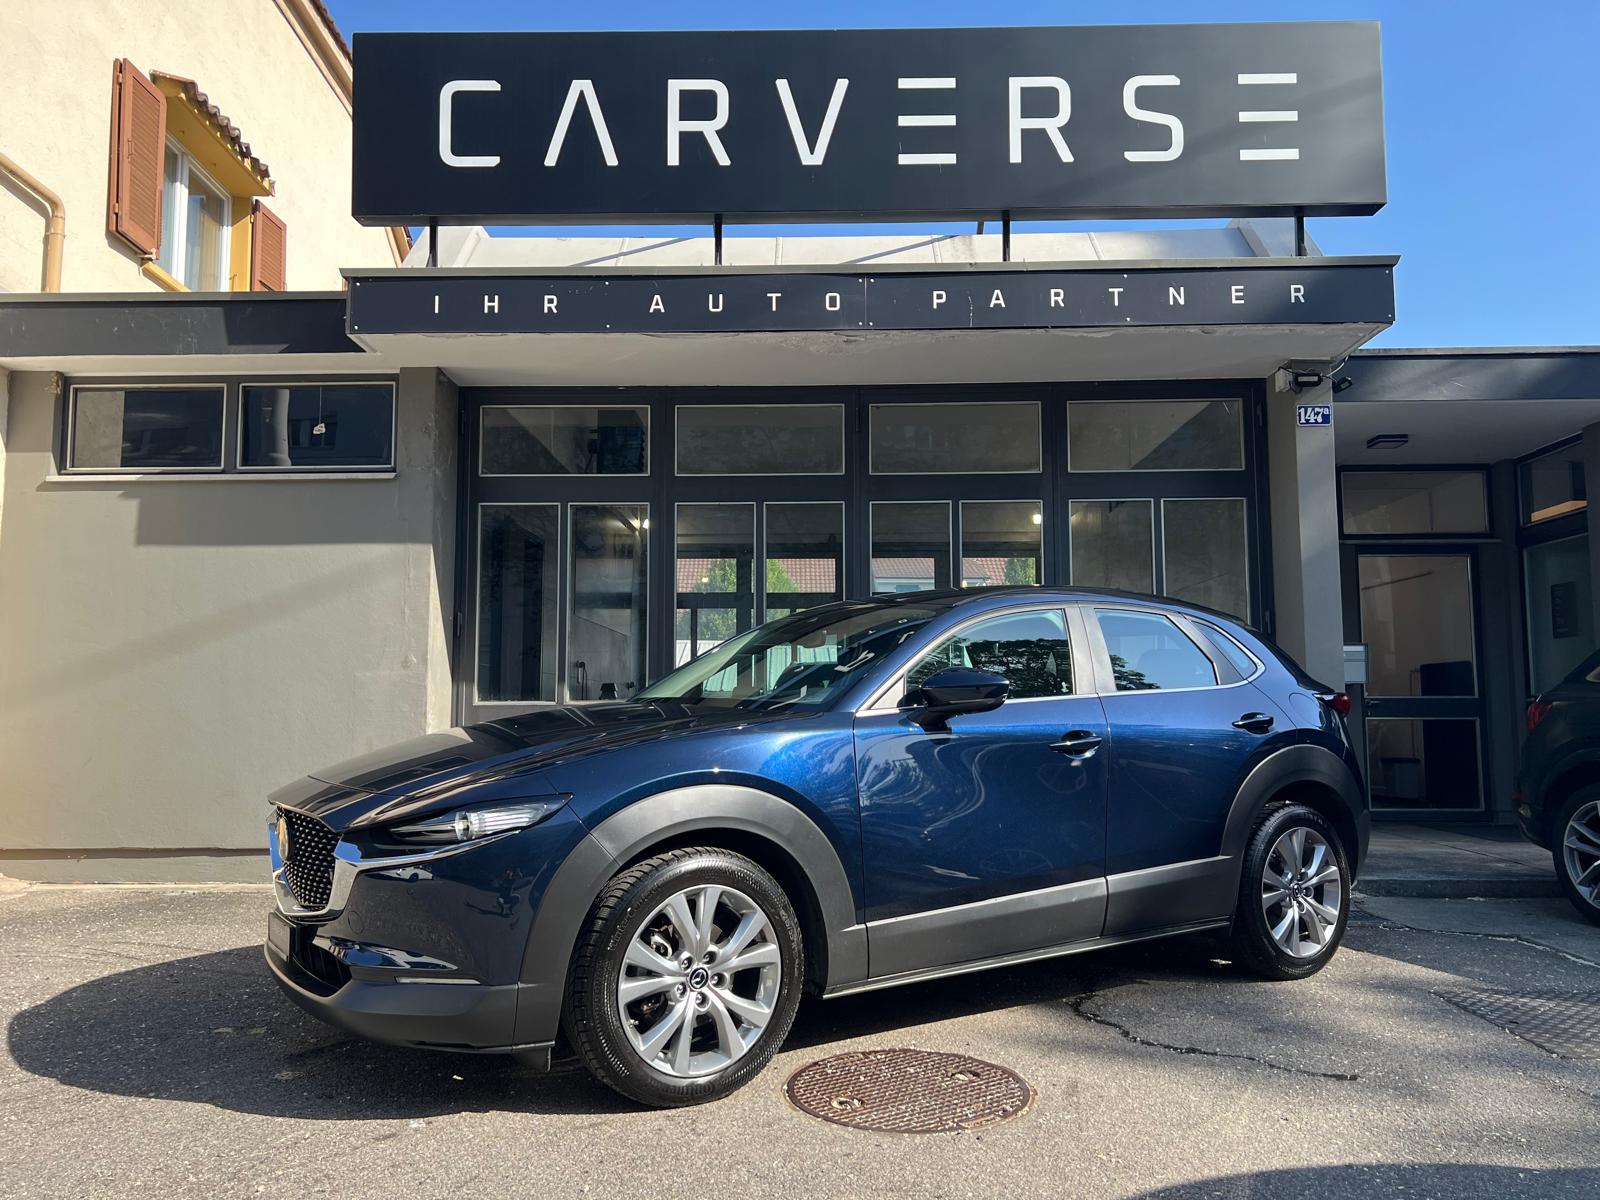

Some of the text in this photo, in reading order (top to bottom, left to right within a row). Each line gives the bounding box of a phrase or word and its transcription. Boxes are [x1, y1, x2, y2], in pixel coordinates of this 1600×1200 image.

[439, 72, 1301, 168] CARVERSE
[434, 284, 1306, 314] IHR AUTO PARTNER
[1298, 407, 1330, 424] 147a
